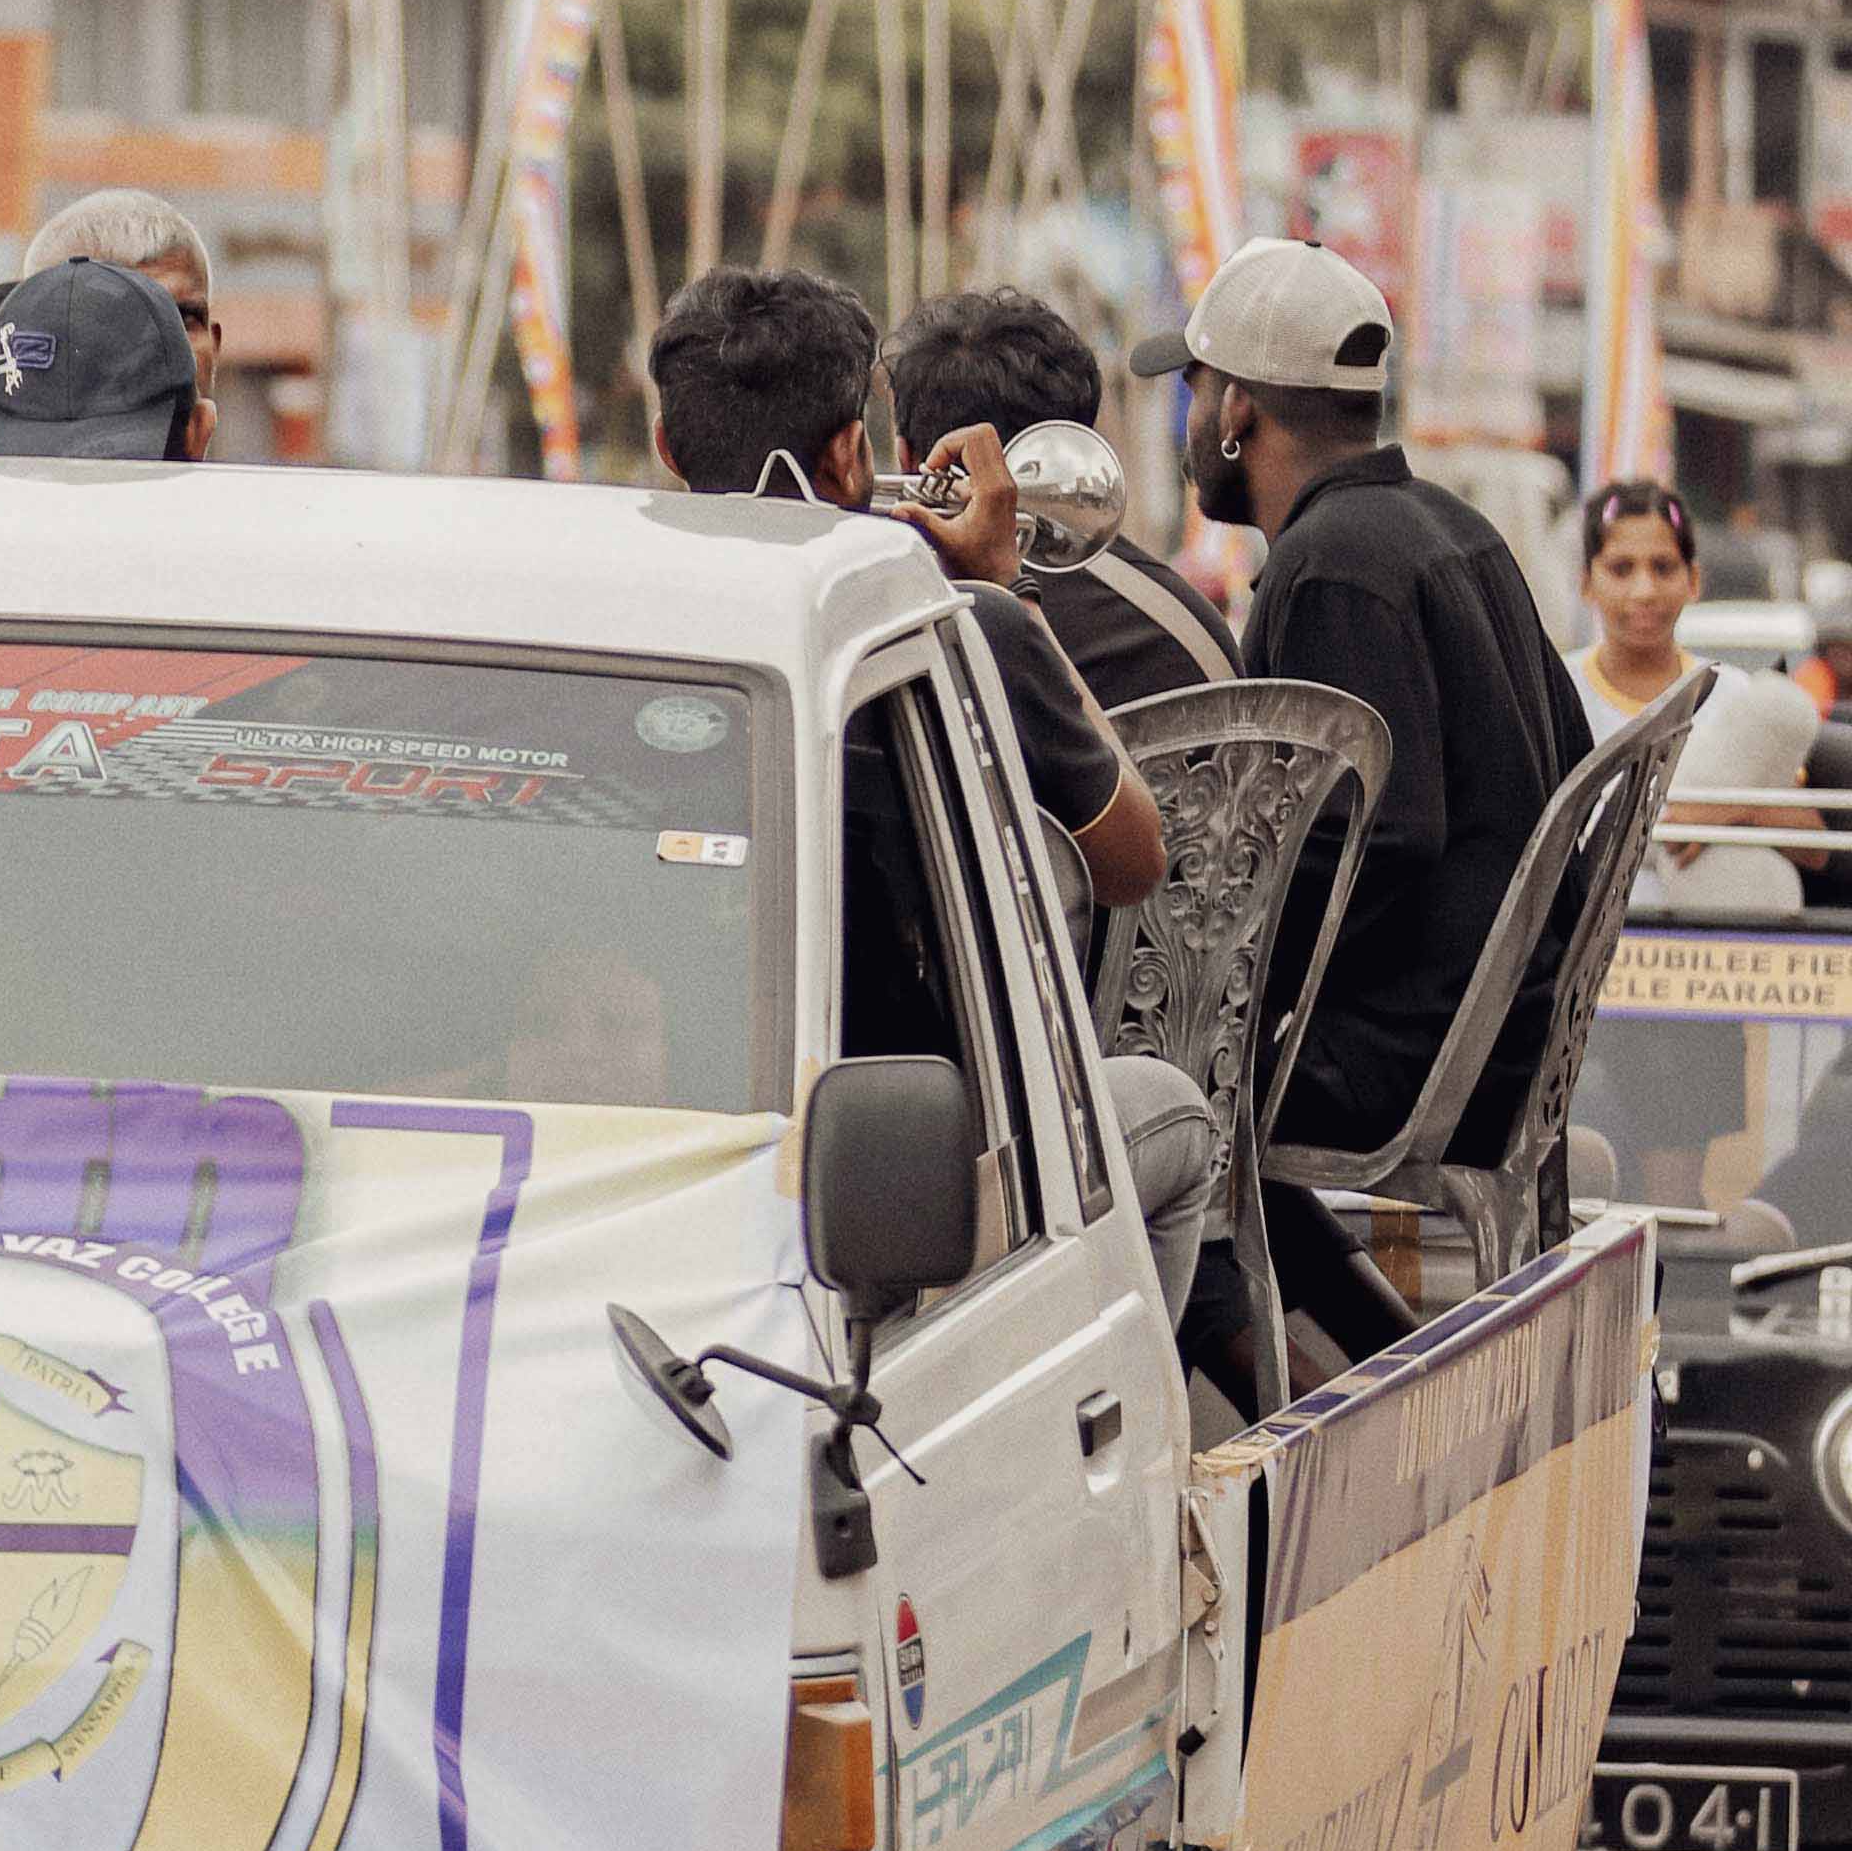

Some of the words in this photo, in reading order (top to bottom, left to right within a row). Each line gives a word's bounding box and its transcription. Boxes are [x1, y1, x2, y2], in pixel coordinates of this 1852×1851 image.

[28, 689, 209, 717] COMPANY
[389, 737, 471, 760] SPEED
[477, 744, 569, 769] MOTOR
[198, 751, 548, 807] SPORT
[1788, 952, 1852, 977] FIE
[1685, 979, 1836, 1007] PARADE
[0, 1232, 118, 1270] VAZ
[115, 1254, 282, 1376] COLLEGE
